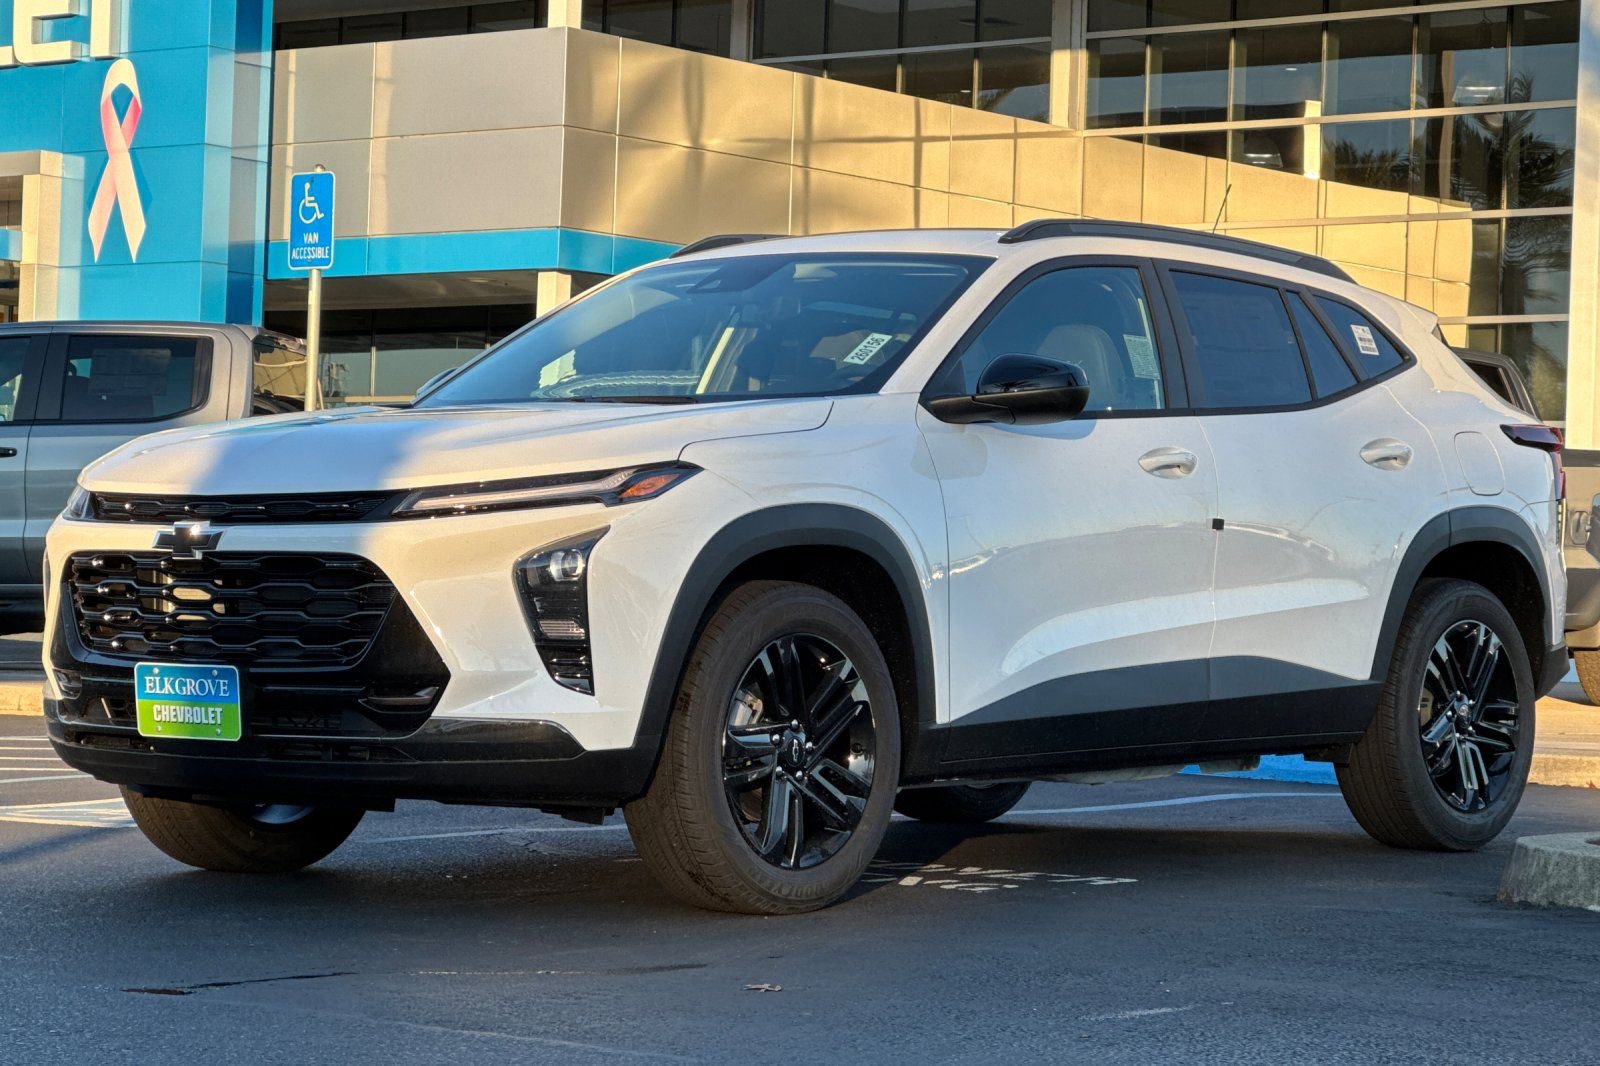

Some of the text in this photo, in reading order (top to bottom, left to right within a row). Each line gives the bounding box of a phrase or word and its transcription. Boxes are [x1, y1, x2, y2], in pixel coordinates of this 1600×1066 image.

[303, 231, 319, 244] VAN
[291, 246, 330, 260] ACCESSIBLE
[153, 704, 223, 725] CHEVROLET
